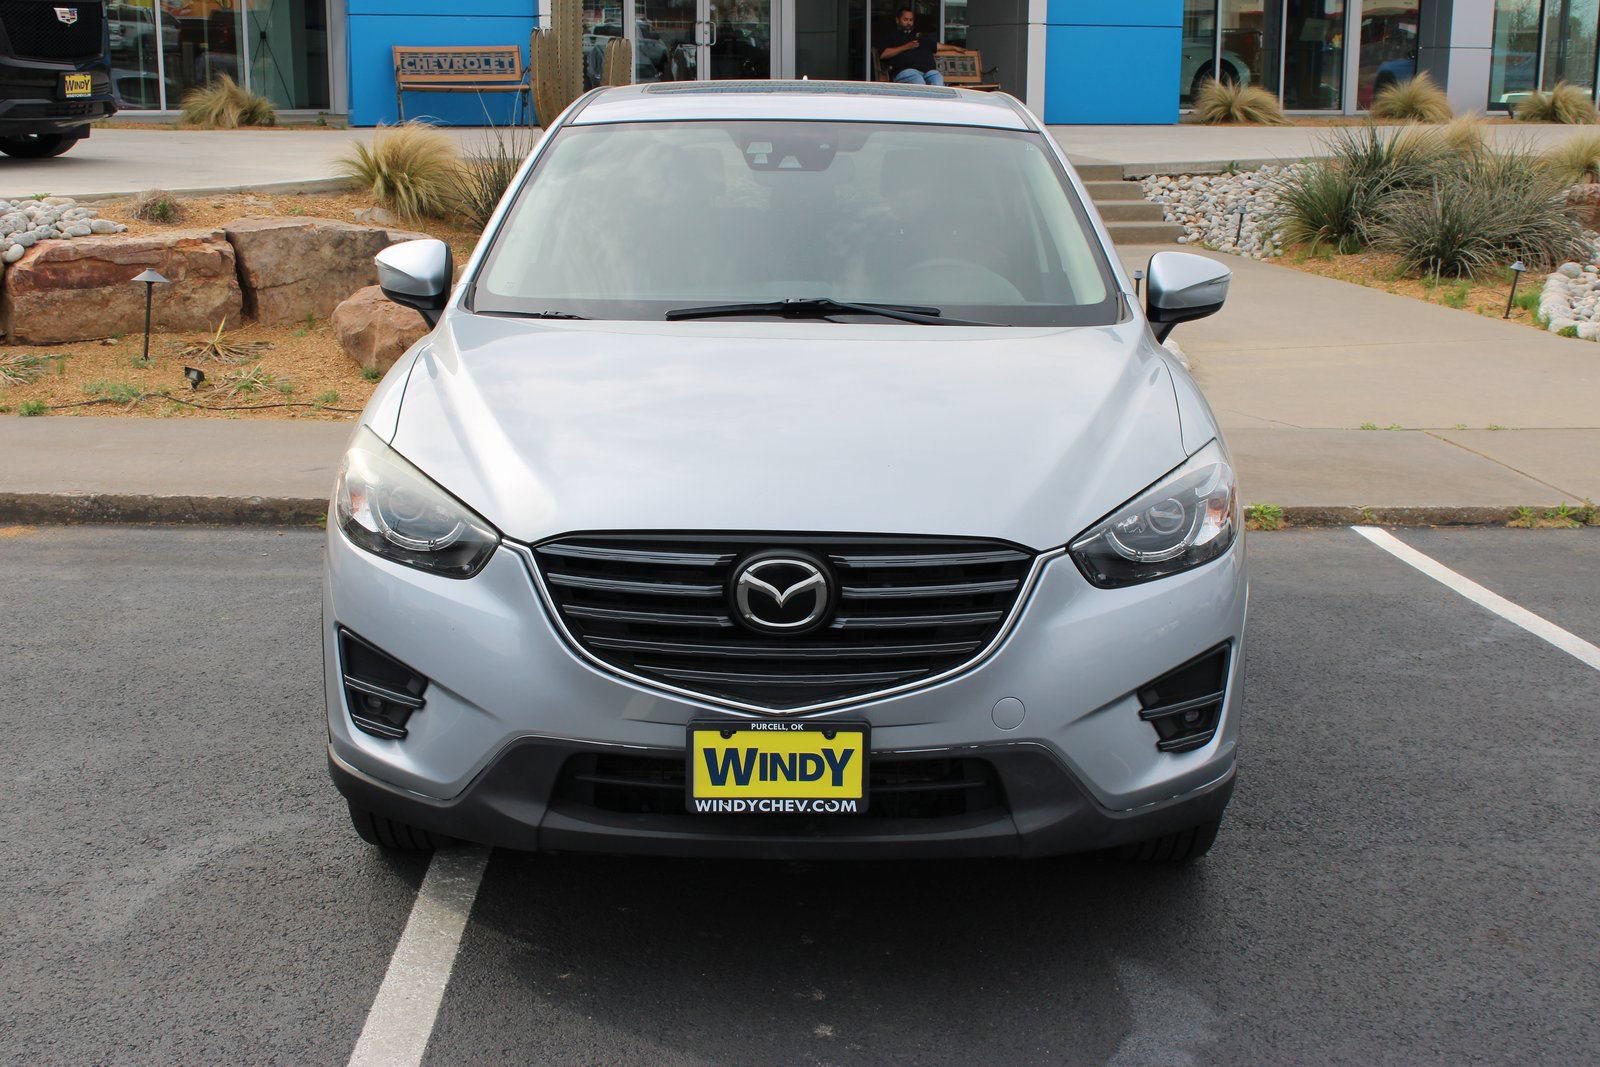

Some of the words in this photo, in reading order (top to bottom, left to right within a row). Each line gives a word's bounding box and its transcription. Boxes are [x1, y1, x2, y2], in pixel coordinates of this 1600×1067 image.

[402, 57, 514, 69] CHEVROLET
[65, 80, 90, 91] WINDY
[751, 723, 788, 731] PURCELL,
[790, 723, 804, 731] OK
[703, 747, 855, 787] WINDY
[695, 799, 857, 812] WINDYCHEV.COM
